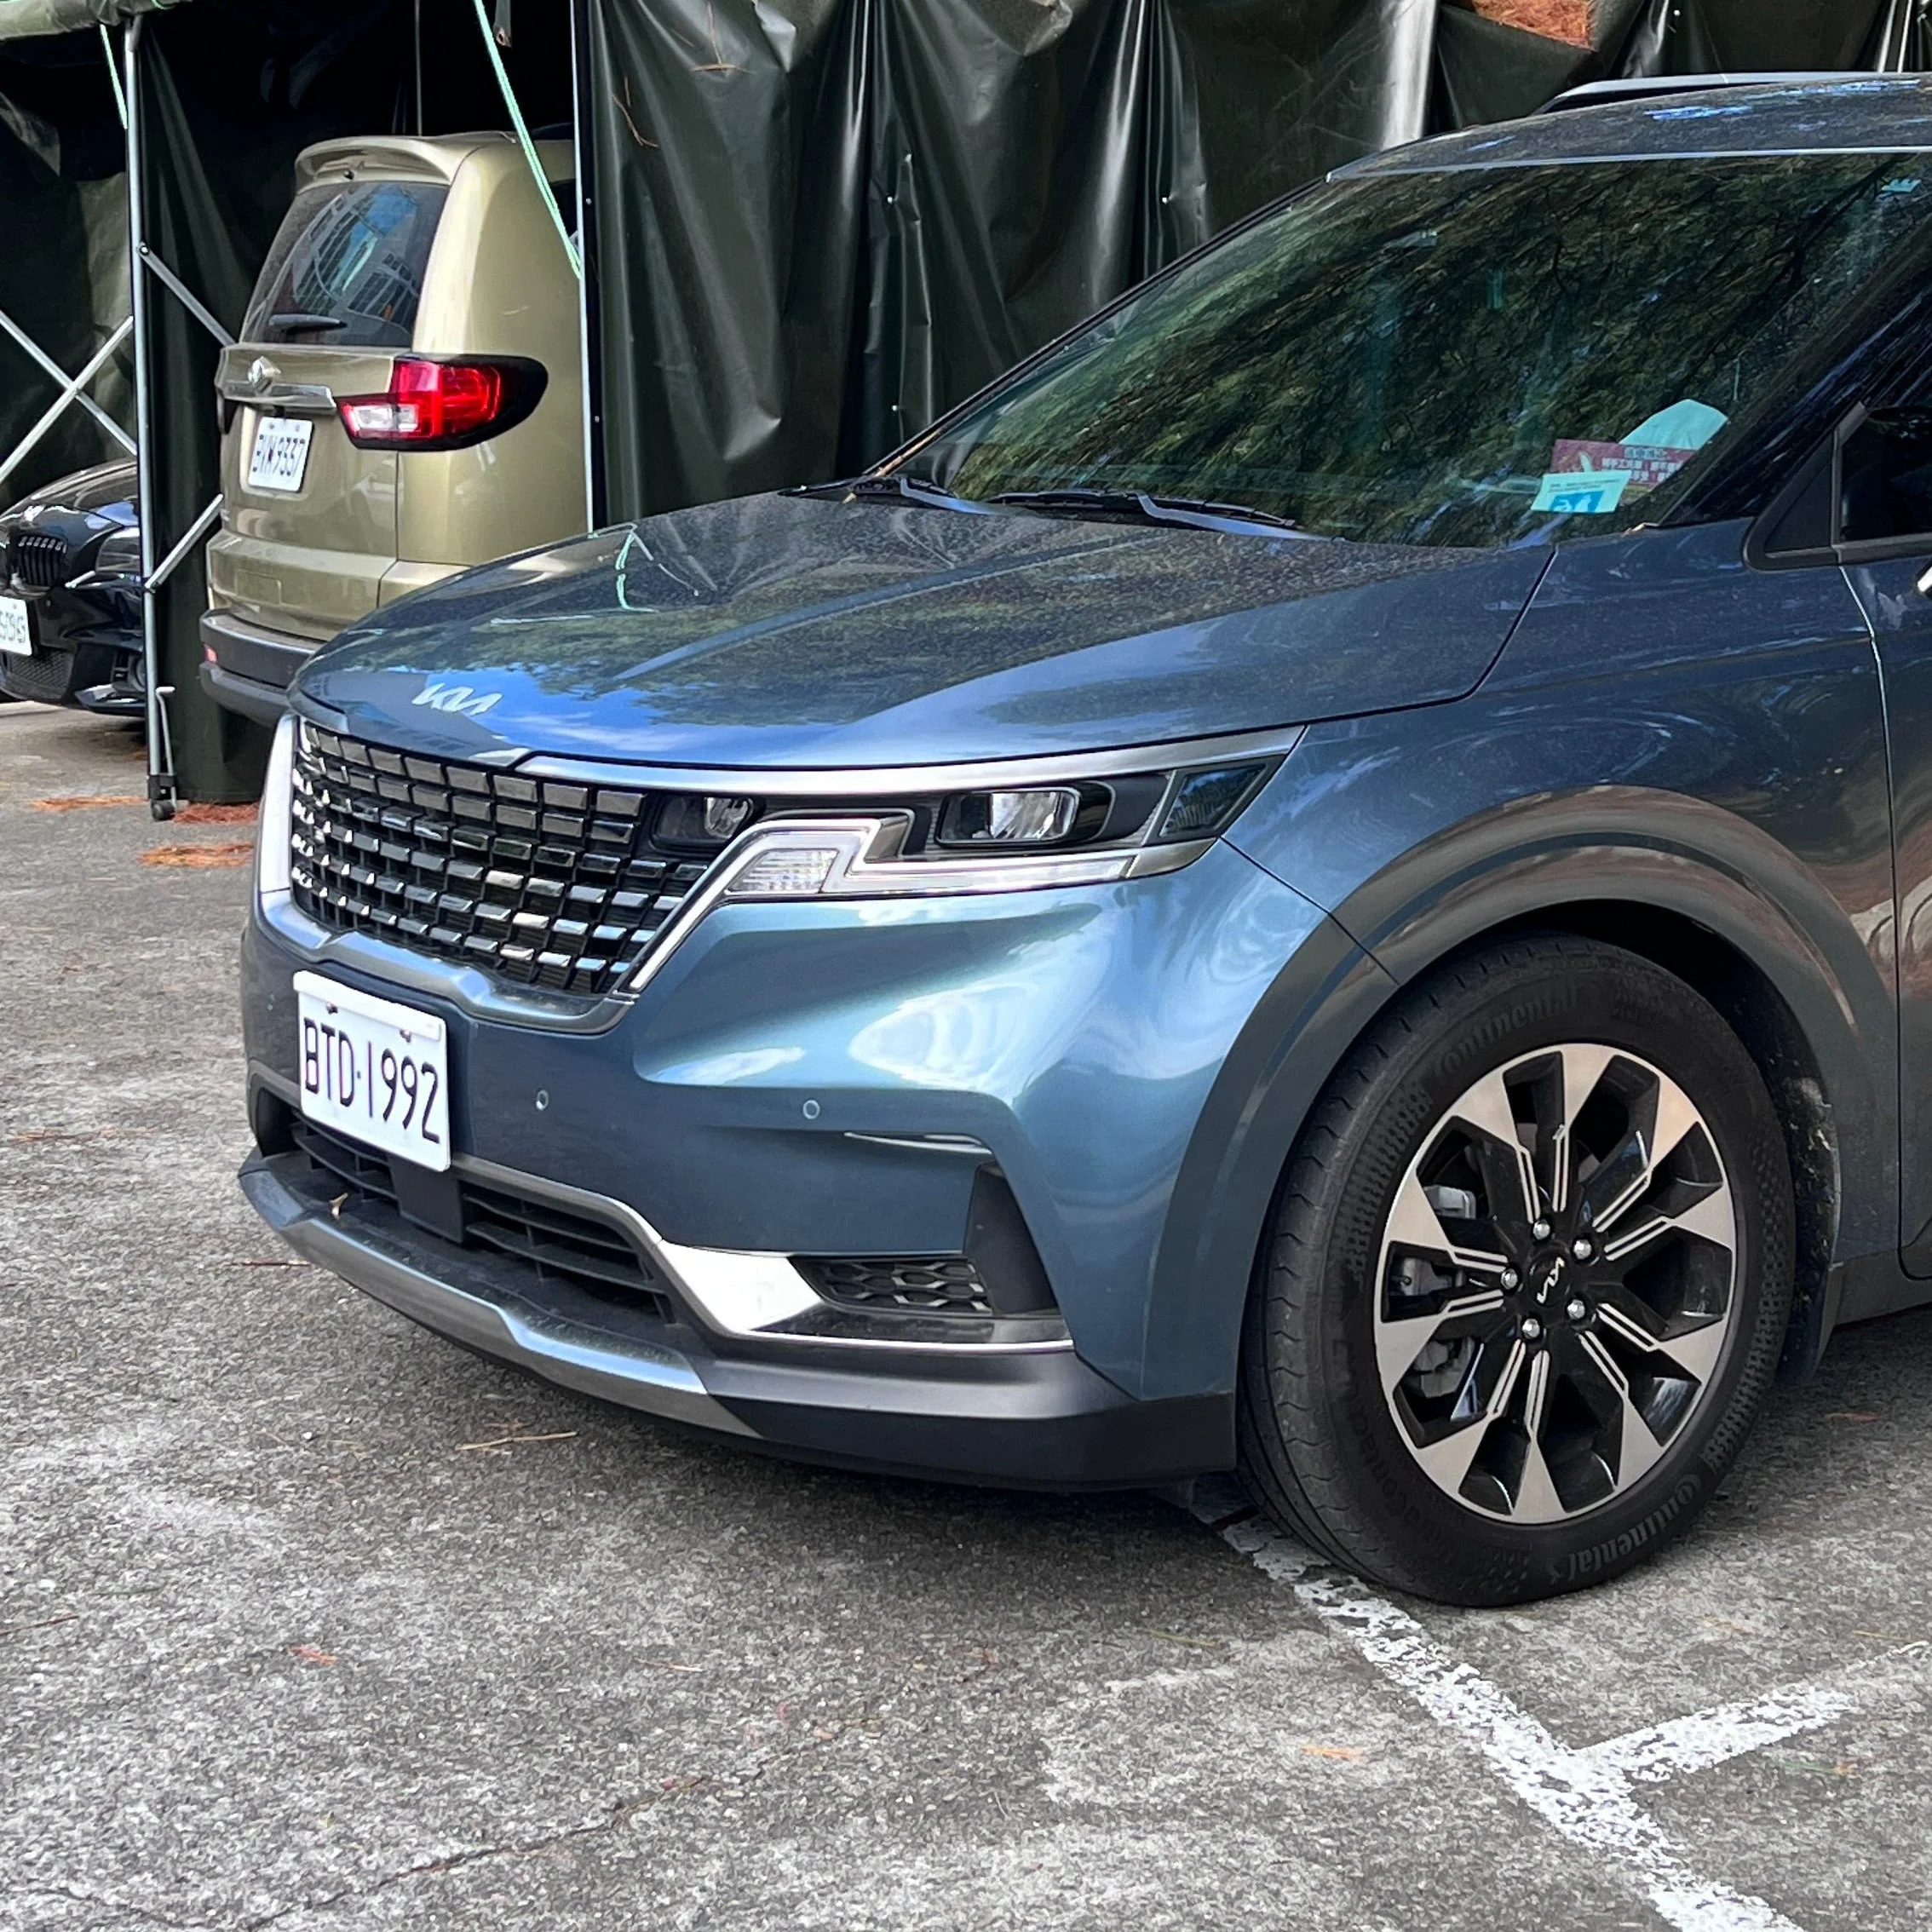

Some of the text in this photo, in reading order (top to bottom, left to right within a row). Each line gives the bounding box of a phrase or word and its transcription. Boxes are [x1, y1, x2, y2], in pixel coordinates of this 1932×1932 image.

[411, 681, 503, 716] KIA
[303, 1016, 440, 1145] BTD-1992
[1566, 1473, 1703, 1582] Continental
